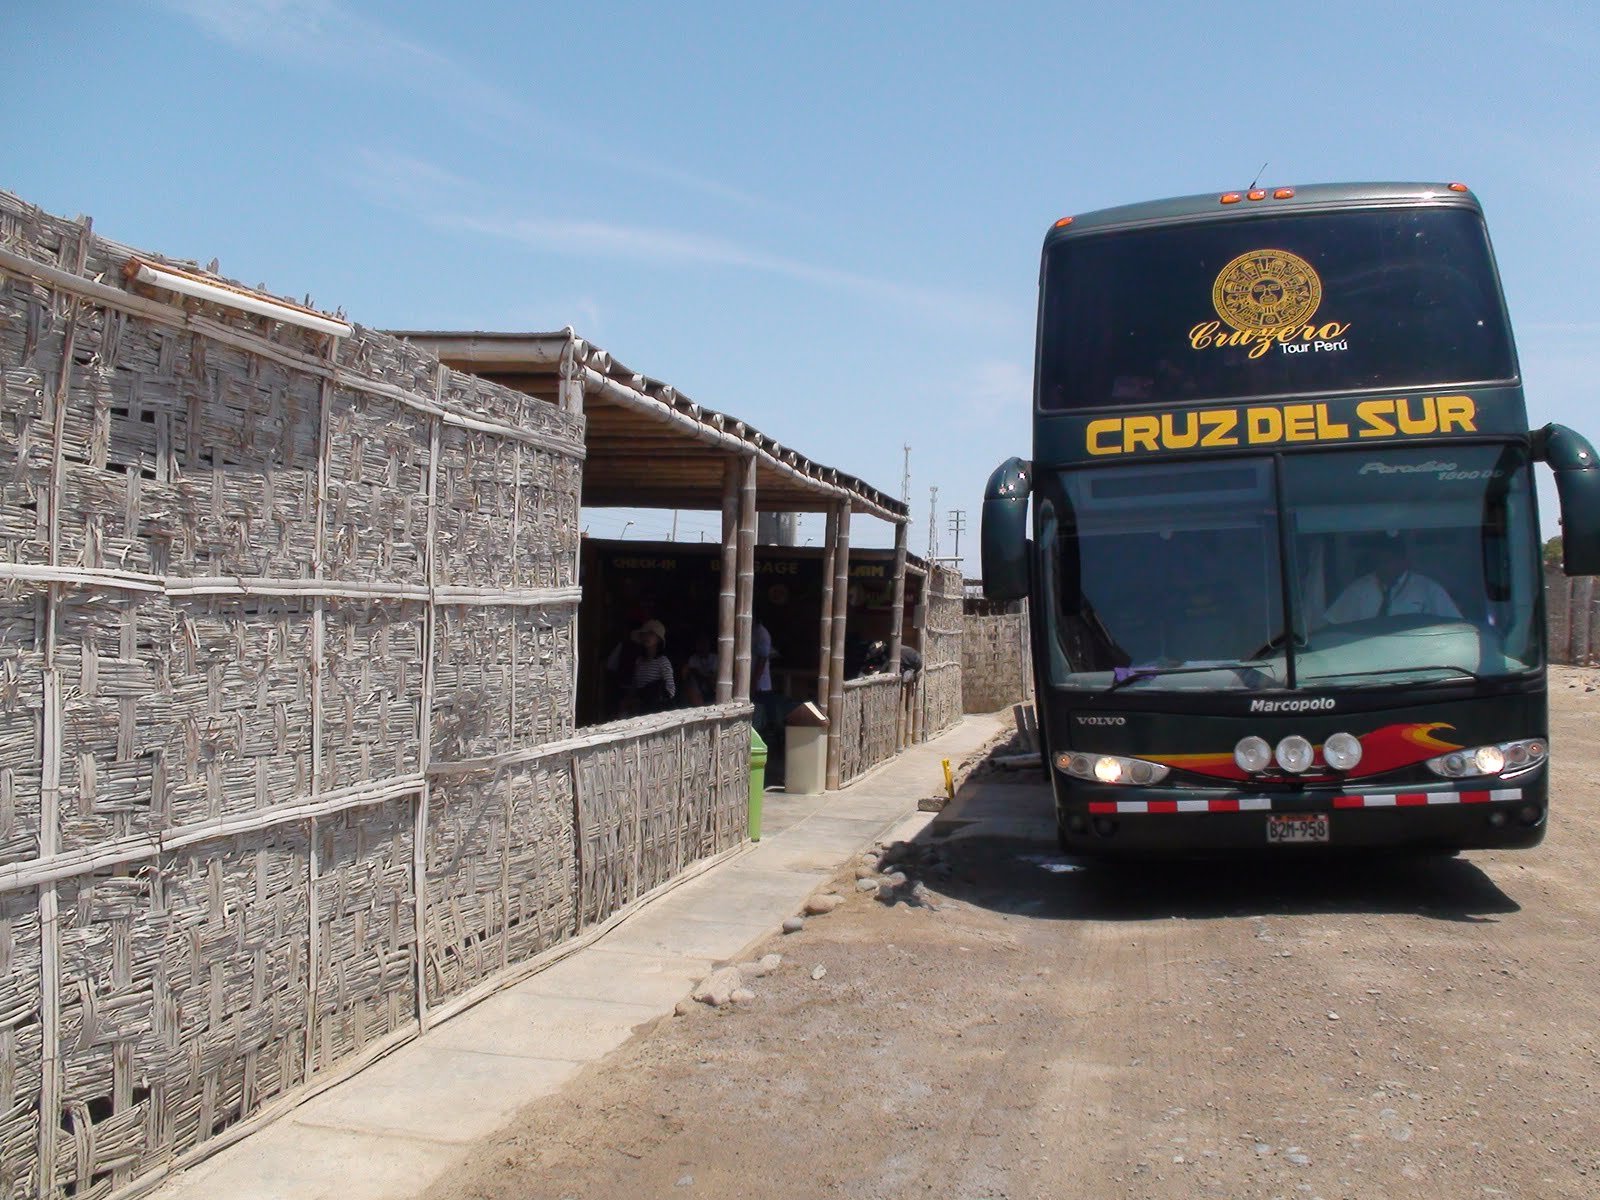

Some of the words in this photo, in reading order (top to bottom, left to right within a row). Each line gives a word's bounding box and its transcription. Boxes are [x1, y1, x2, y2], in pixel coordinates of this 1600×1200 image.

[1188, 321, 1351, 359] Cruzero
[1280, 343, 1310, 354] Tour
[1314, 339, 1348, 352] Perú
[1086, 409, 1239, 456] CRUZ
[1247, 403, 1349, 444] DEL
[1356, 395, 1478, 438] SUR
[1250, 697, 1336, 713] Marcopolo
[1076, 716, 1127, 726] VOLVO
